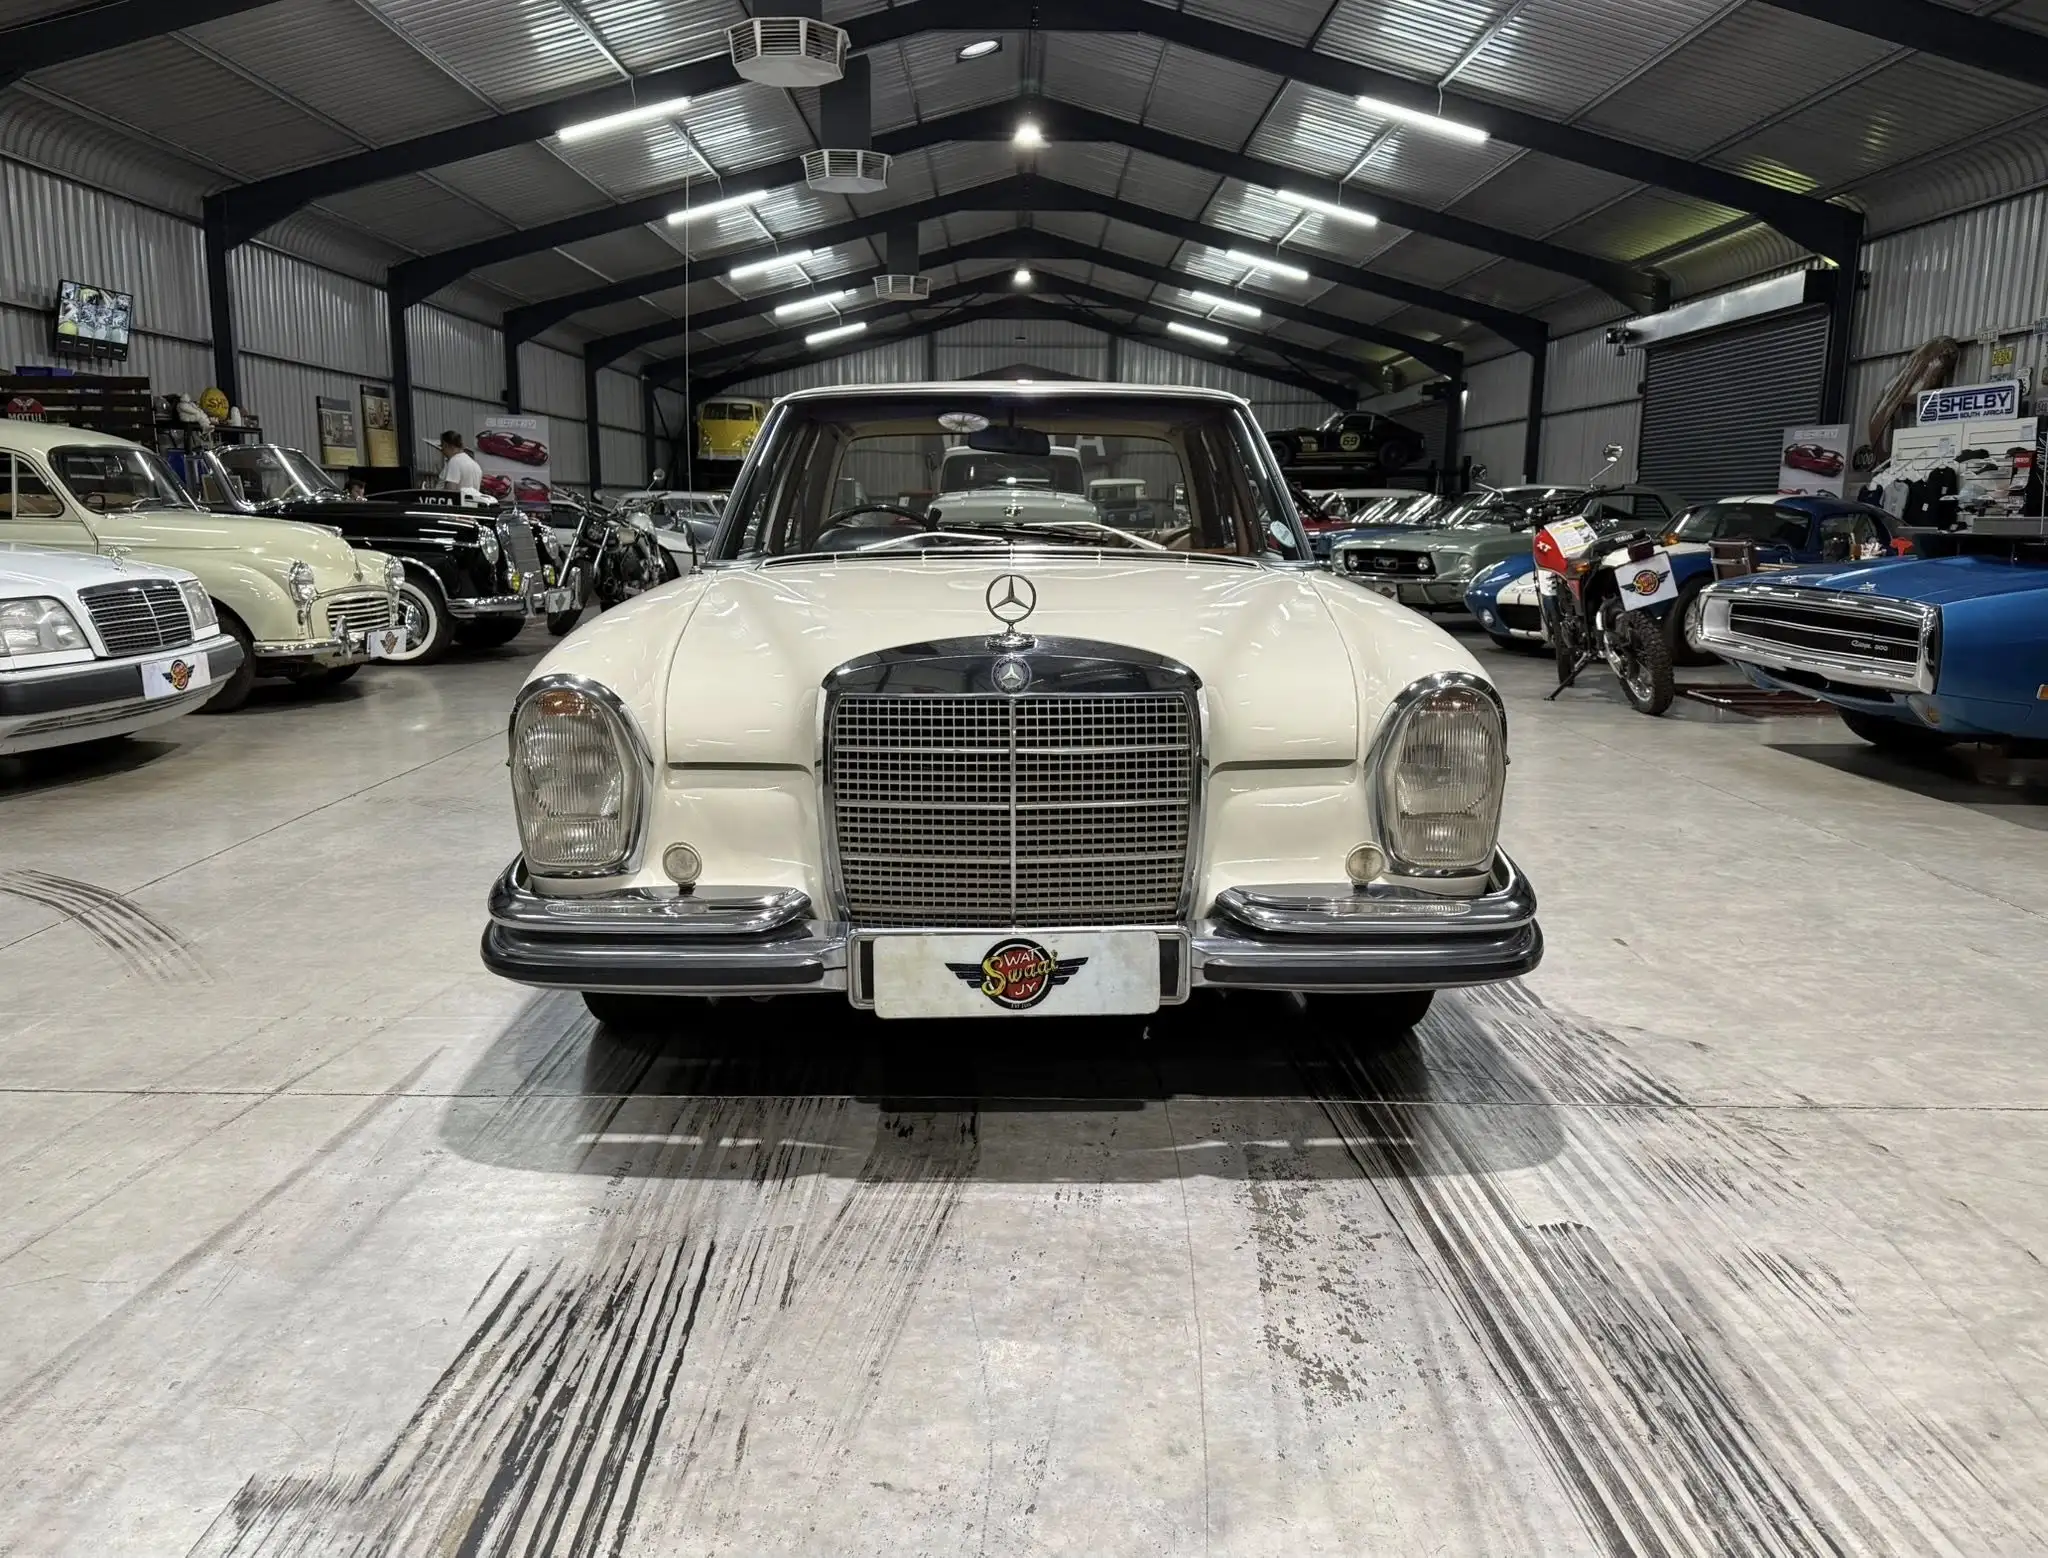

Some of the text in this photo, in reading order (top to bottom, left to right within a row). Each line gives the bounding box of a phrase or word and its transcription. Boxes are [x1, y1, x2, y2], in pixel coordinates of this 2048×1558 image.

[1940, 392, 2010, 413] SHELBY
[8, 412, 45, 422] MOTUL
[1959, 411, 1980, 419] SOUTH
[1537, 541, 1551, 552] XT
[1003, 946, 1043, 967] WAT
[1014, 981, 1037, 996] JY
